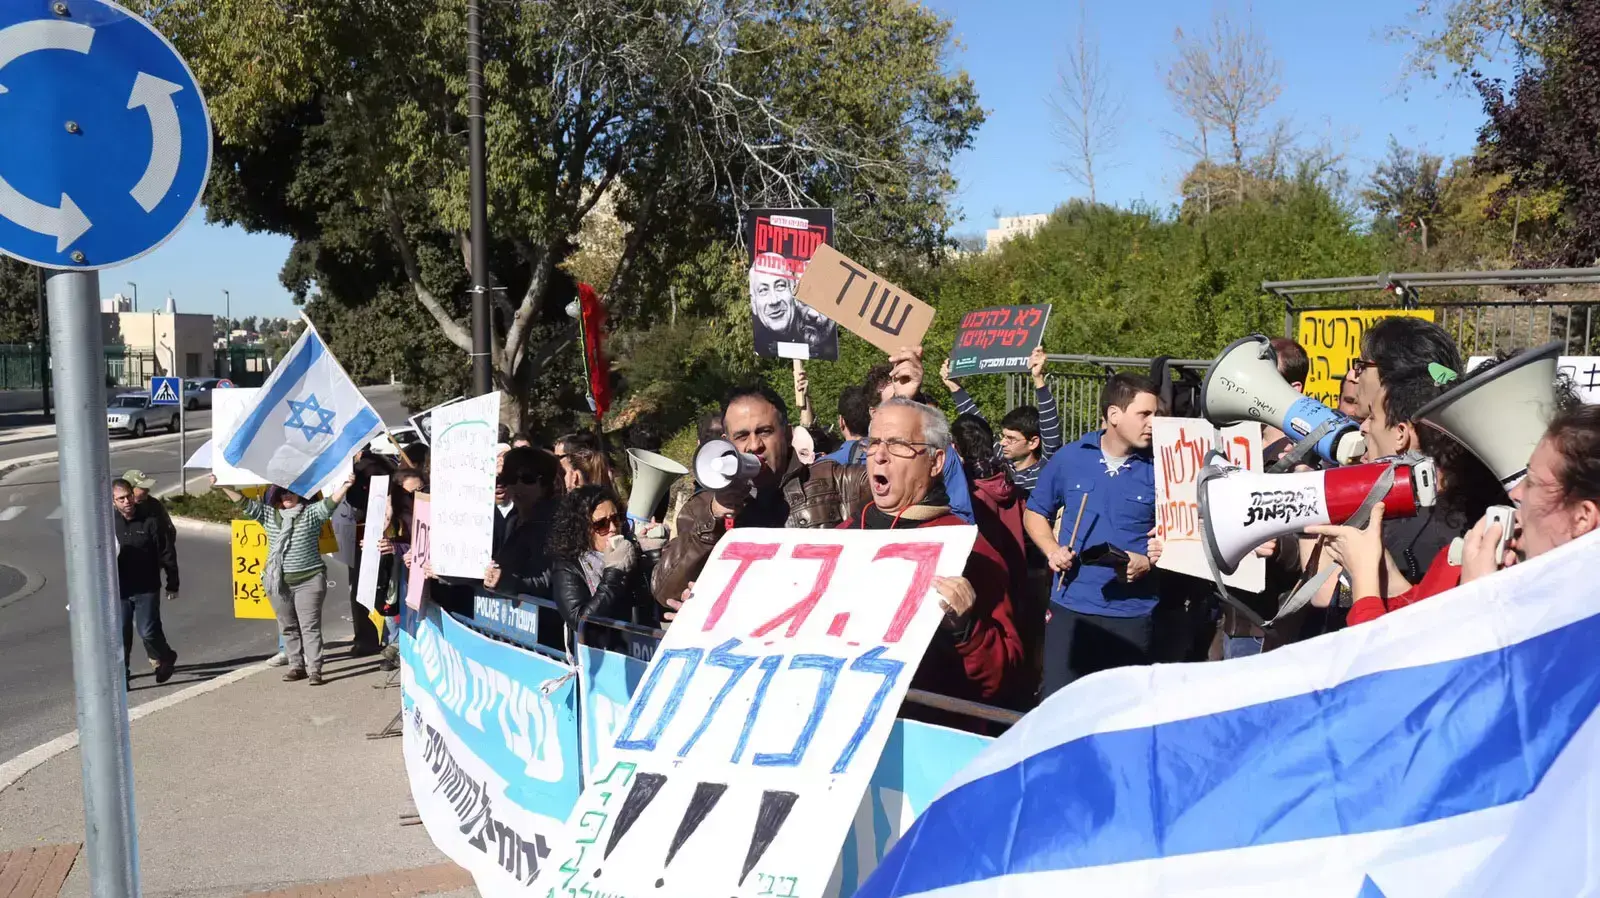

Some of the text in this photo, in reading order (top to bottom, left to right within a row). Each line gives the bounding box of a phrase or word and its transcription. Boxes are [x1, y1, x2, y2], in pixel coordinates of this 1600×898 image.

[757, 224, 823, 259] מסריחים
[756, 255, 809, 274] שחיתות
[836, 259, 914, 336] שוד
[961, 307, 1043, 328] לא להיכנע
[958, 328, 1029, 349] לטייקונים!
[476, 596, 500, 621] POLICE
[508, 606, 537, 635] משטרה
[613, 637, 906, 775] לכולם
